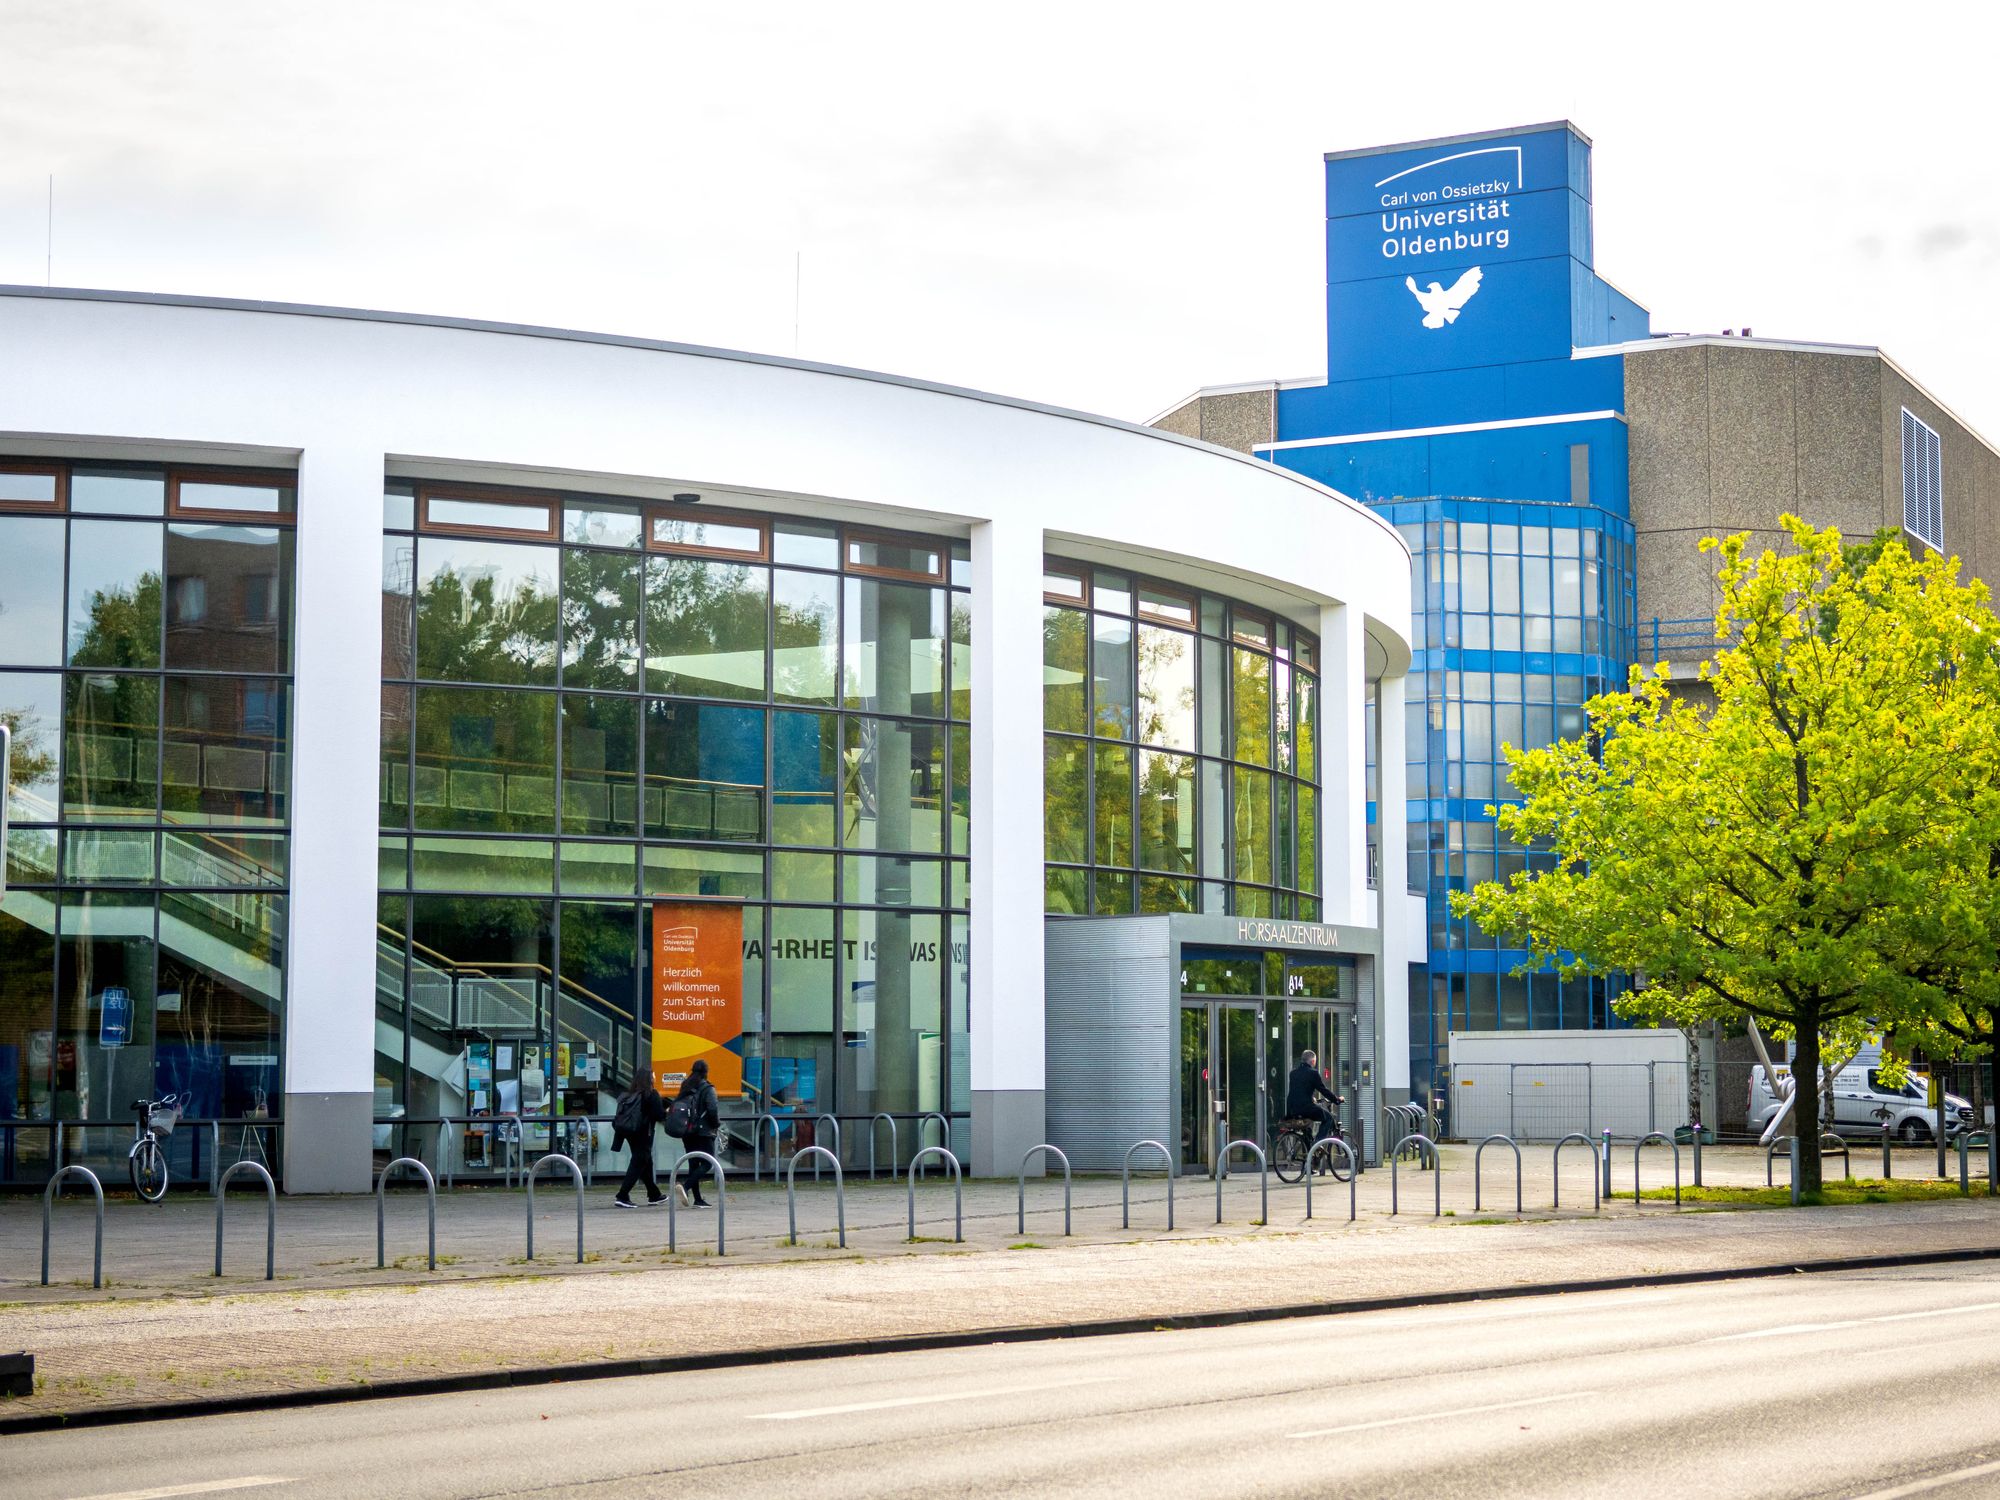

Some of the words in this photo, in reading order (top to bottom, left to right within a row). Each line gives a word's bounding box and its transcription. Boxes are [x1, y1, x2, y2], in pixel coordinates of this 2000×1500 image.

[1381, 192, 1408, 207] Carl
[1412, 190, 1437, 203] von
[1441, 180, 1510, 199] Ossietzky
[1382, 200, 1510, 233] Universität
[1382, 229, 1510, 258] Oldenburg
[663, 945, 695, 953] Oldenburg
[743, 939, 857, 960] AHRHET
[663, 967, 702, 977] Herzlich
[662, 981, 720, 992] willkommen
[1288, 975, 1304, 990] A14
[662, 998, 684, 1006] zum
[686, 996, 710, 1006] Start
[711, 996, 726, 1007] ins
[662, 1010, 705, 1021] Studium!
